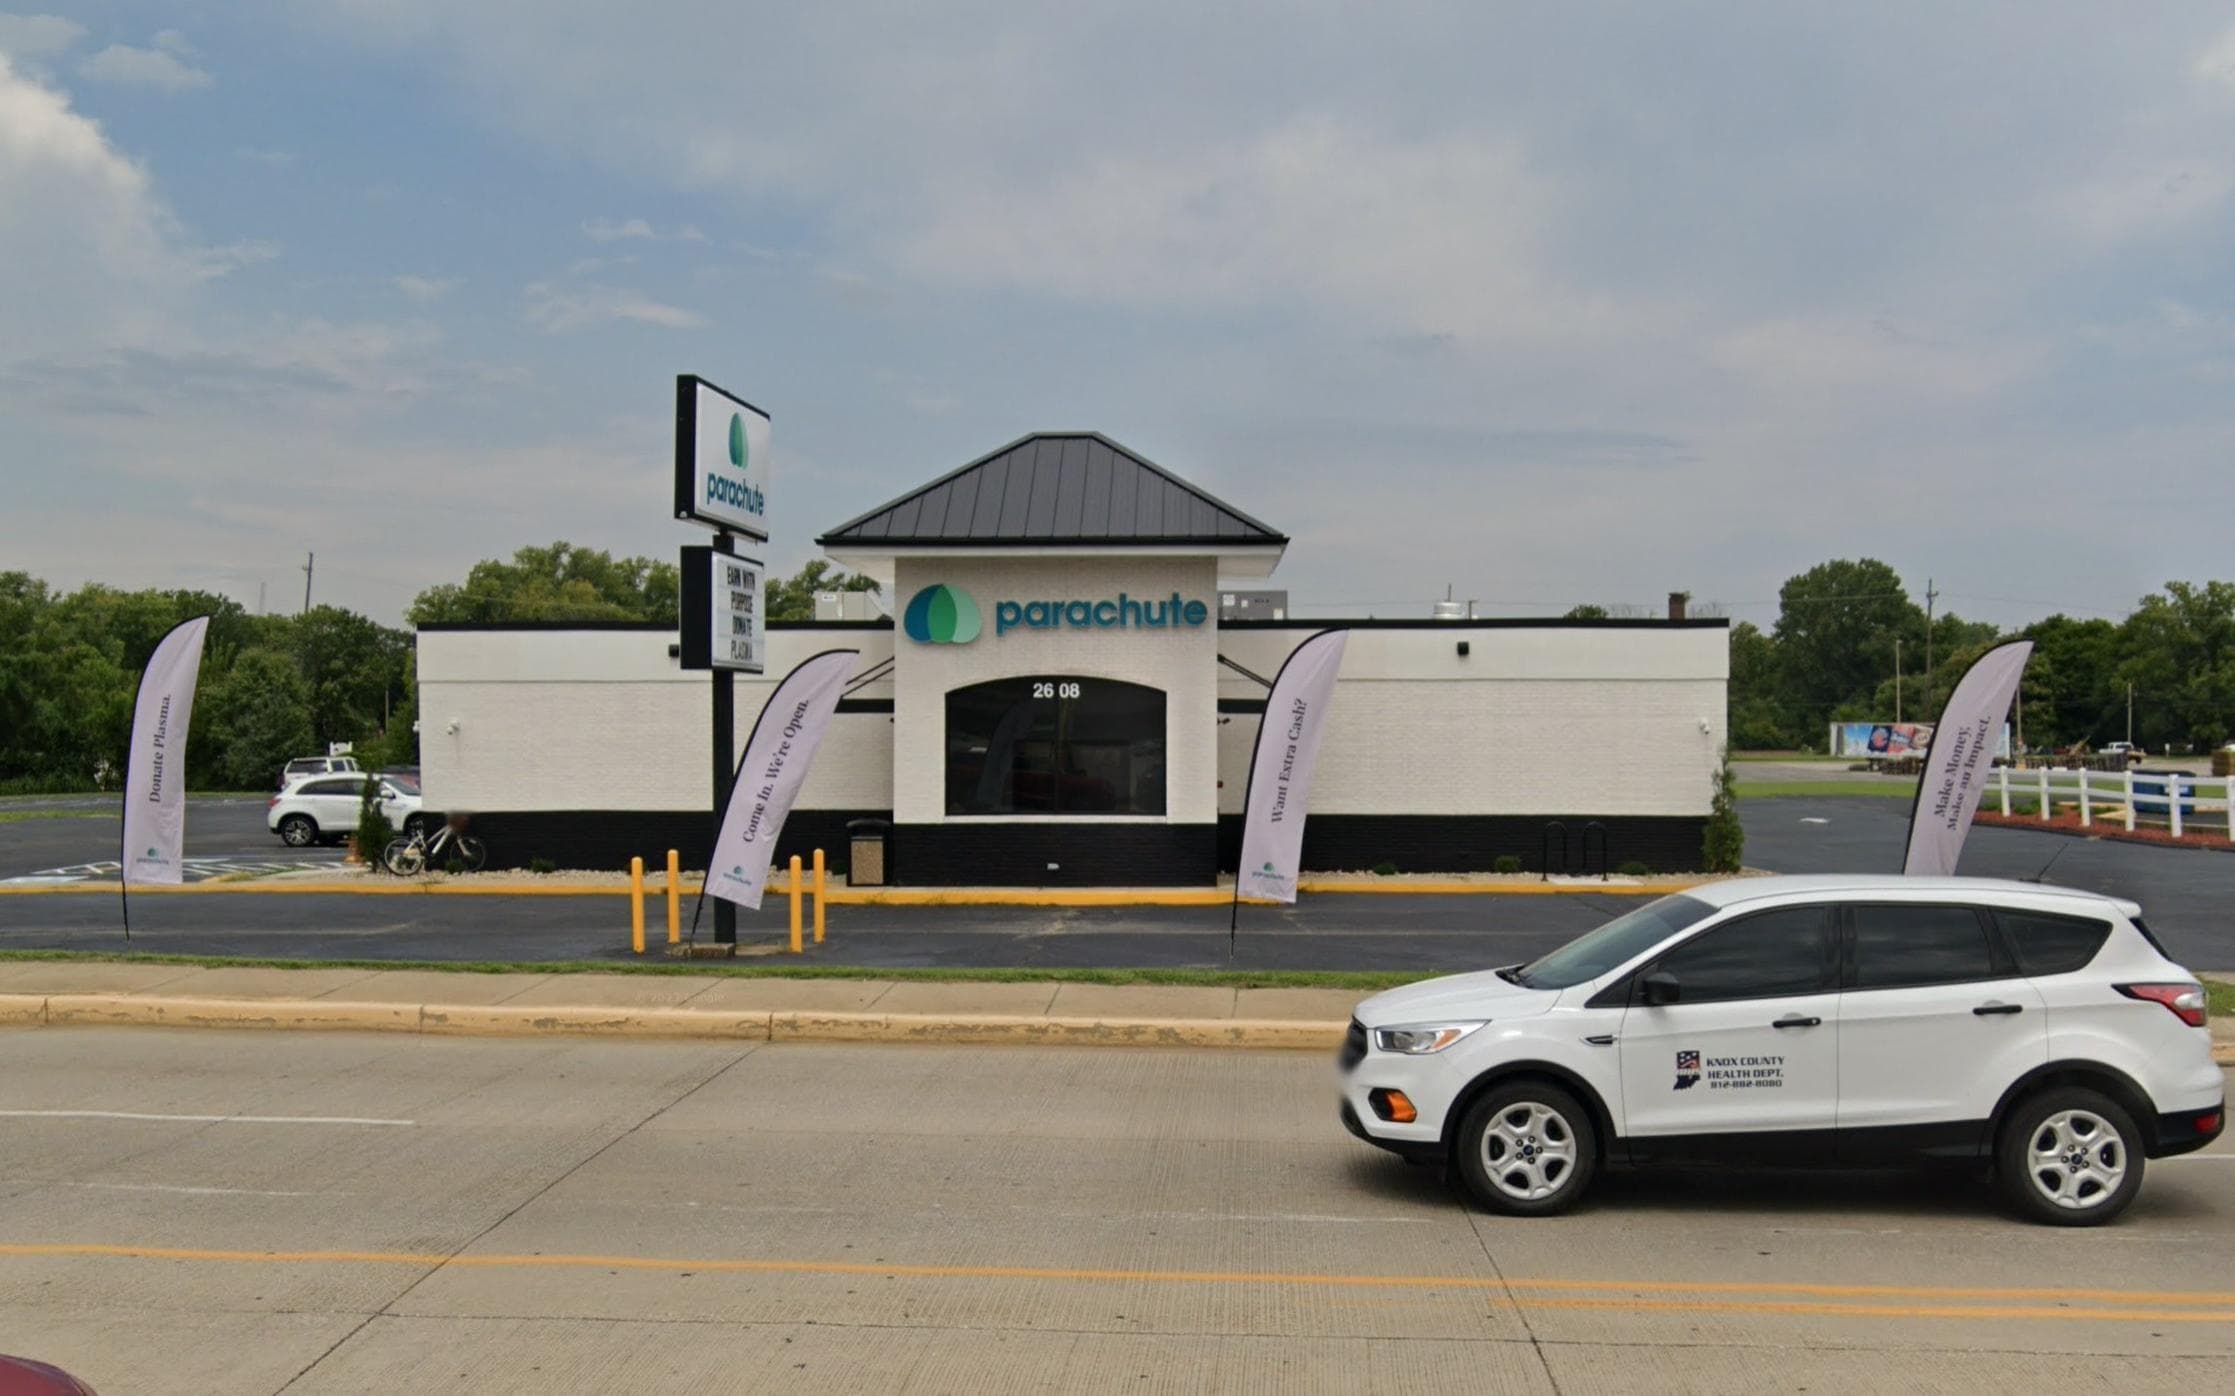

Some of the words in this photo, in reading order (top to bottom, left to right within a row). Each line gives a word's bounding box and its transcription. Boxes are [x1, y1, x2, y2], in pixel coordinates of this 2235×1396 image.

[707, 472, 764, 517] parachute
[995, 592, 1208, 637] parachute
[153, 694, 171, 748] Plasma.
[783, 699, 809, 739] Open.
[1288, 698, 1308, 742] Cash?
[765, 739, 791, 781] We're
[1964, 715, 1991, 769] Impact.
[149, 751, 164, 803] Donate
[1278, 744, 1297, 783] Extra
[1960, 771, 1972, 790] an
[757, 783, 774, 803] In.
[1271, 785, 1288, 823] Want
[1934, 778, 1954, 818] Make
[1947, 792, 1964, 831] Make
[742, 802, 766, 843] Come
[1706, 1057, 1738, 1067] KNOX
[1740, 1055, 1785, 1066] COUNTY
[1708, 1069, 1751, 1079] HEALTH
[1753, 1068, 1784, 1078] DEPT.
